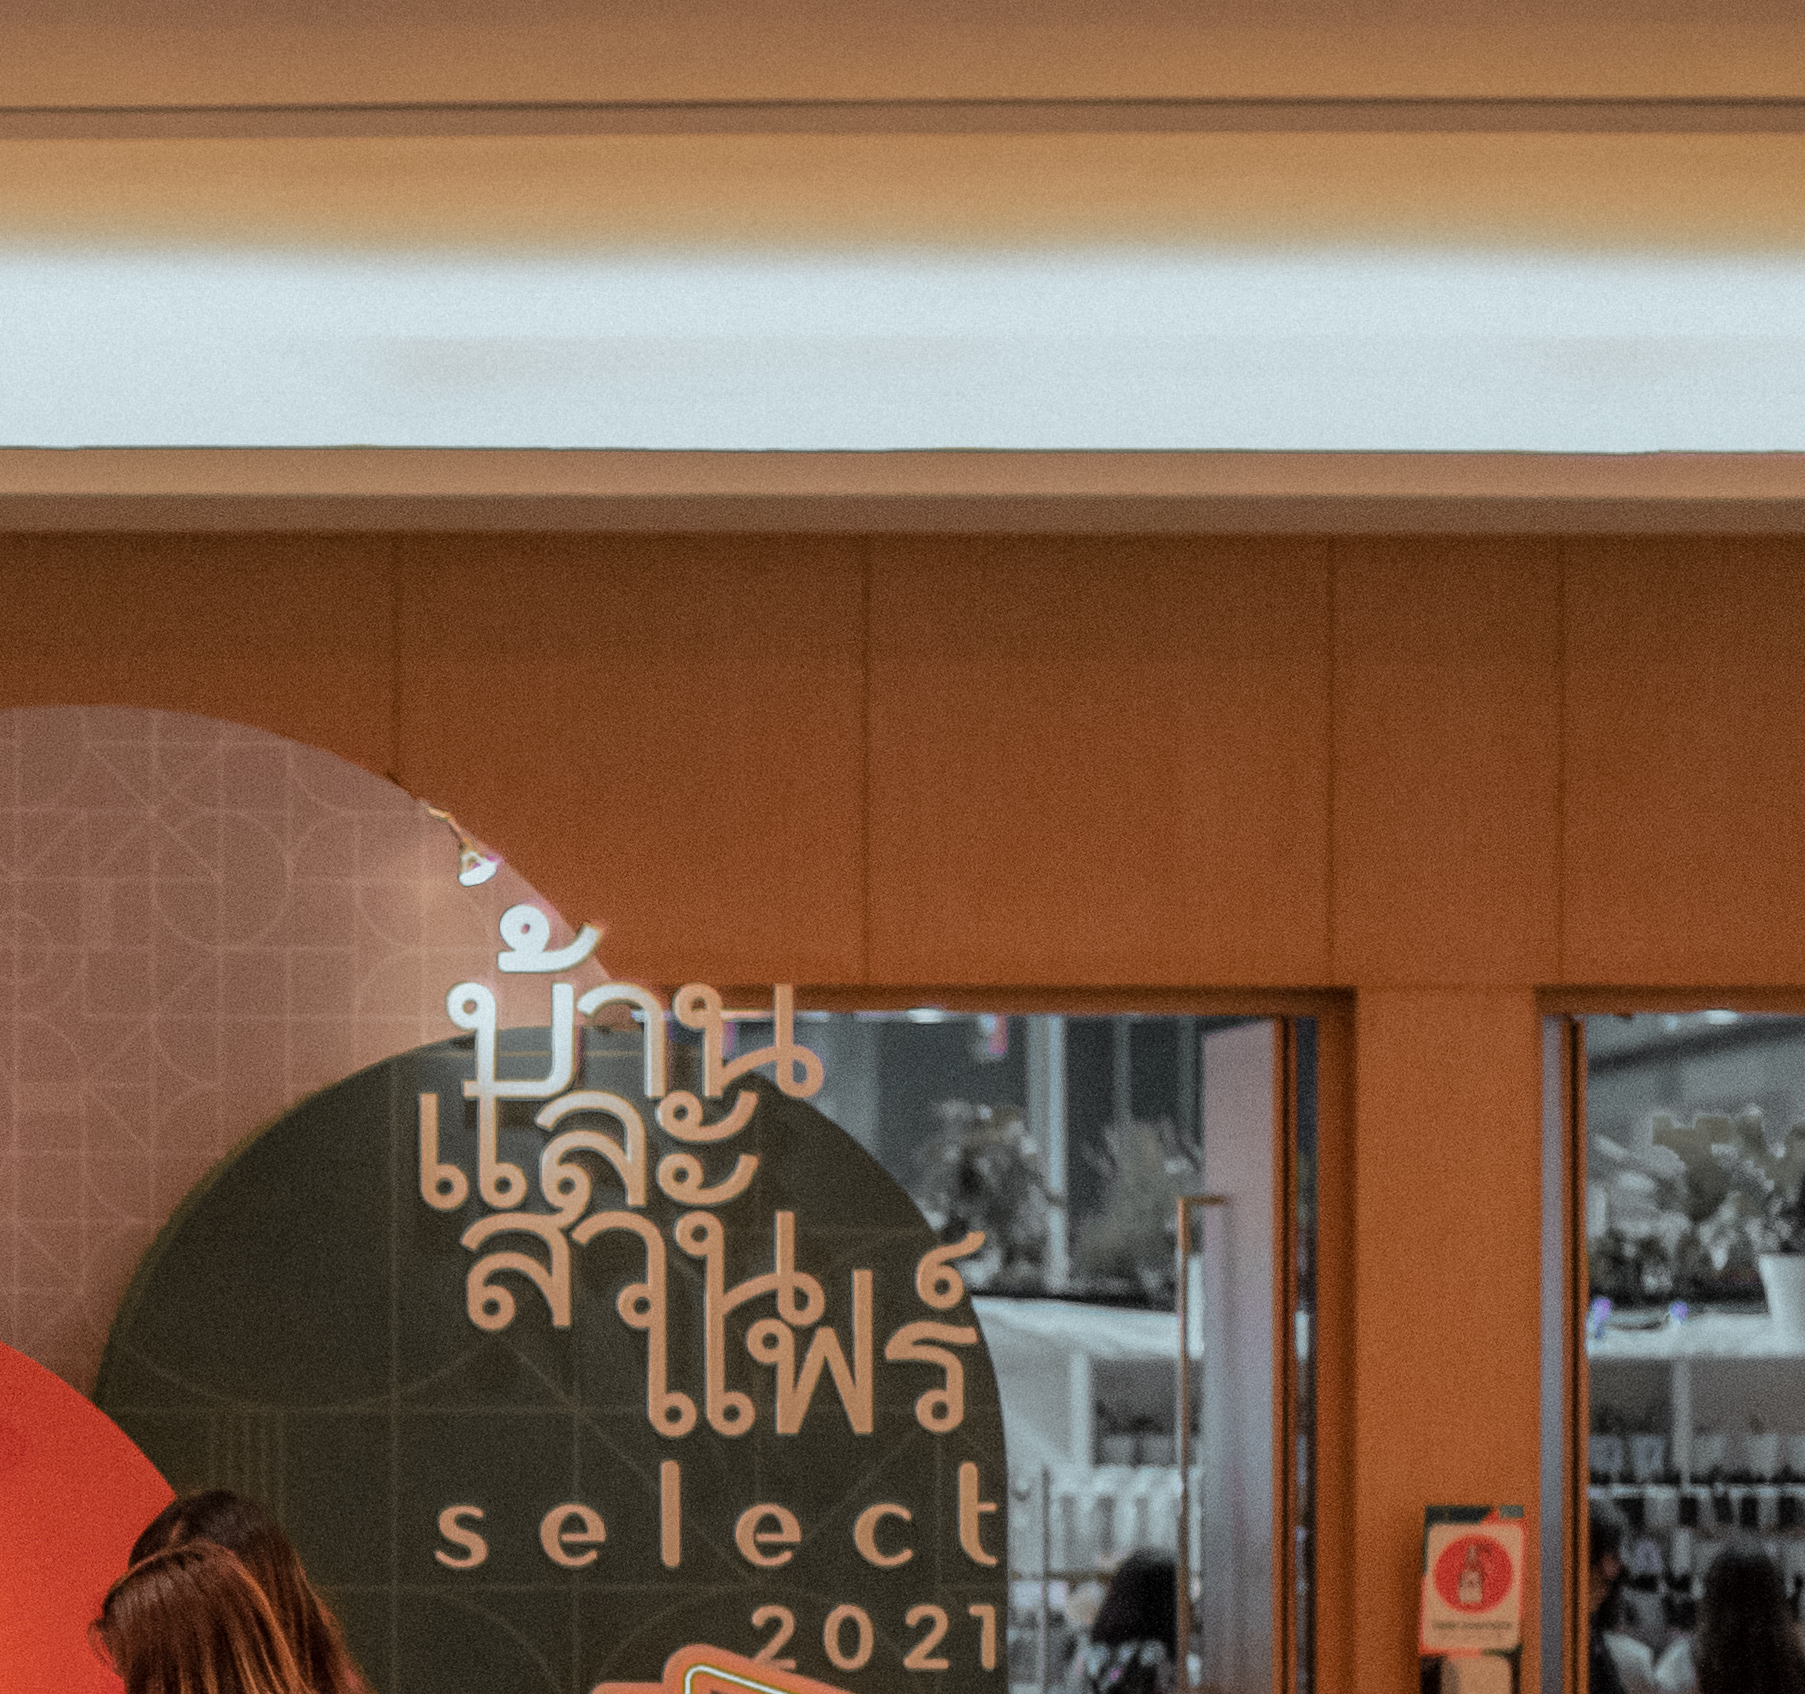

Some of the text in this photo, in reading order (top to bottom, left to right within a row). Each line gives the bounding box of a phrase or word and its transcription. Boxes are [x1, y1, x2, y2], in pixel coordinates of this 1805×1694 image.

[446, 904, 824, 1099] บ้าน
[419, 1089, 761, 1209] และ
[435, 1460, 998, 1568] select
[751, 1605, 997, 1670] 2021
